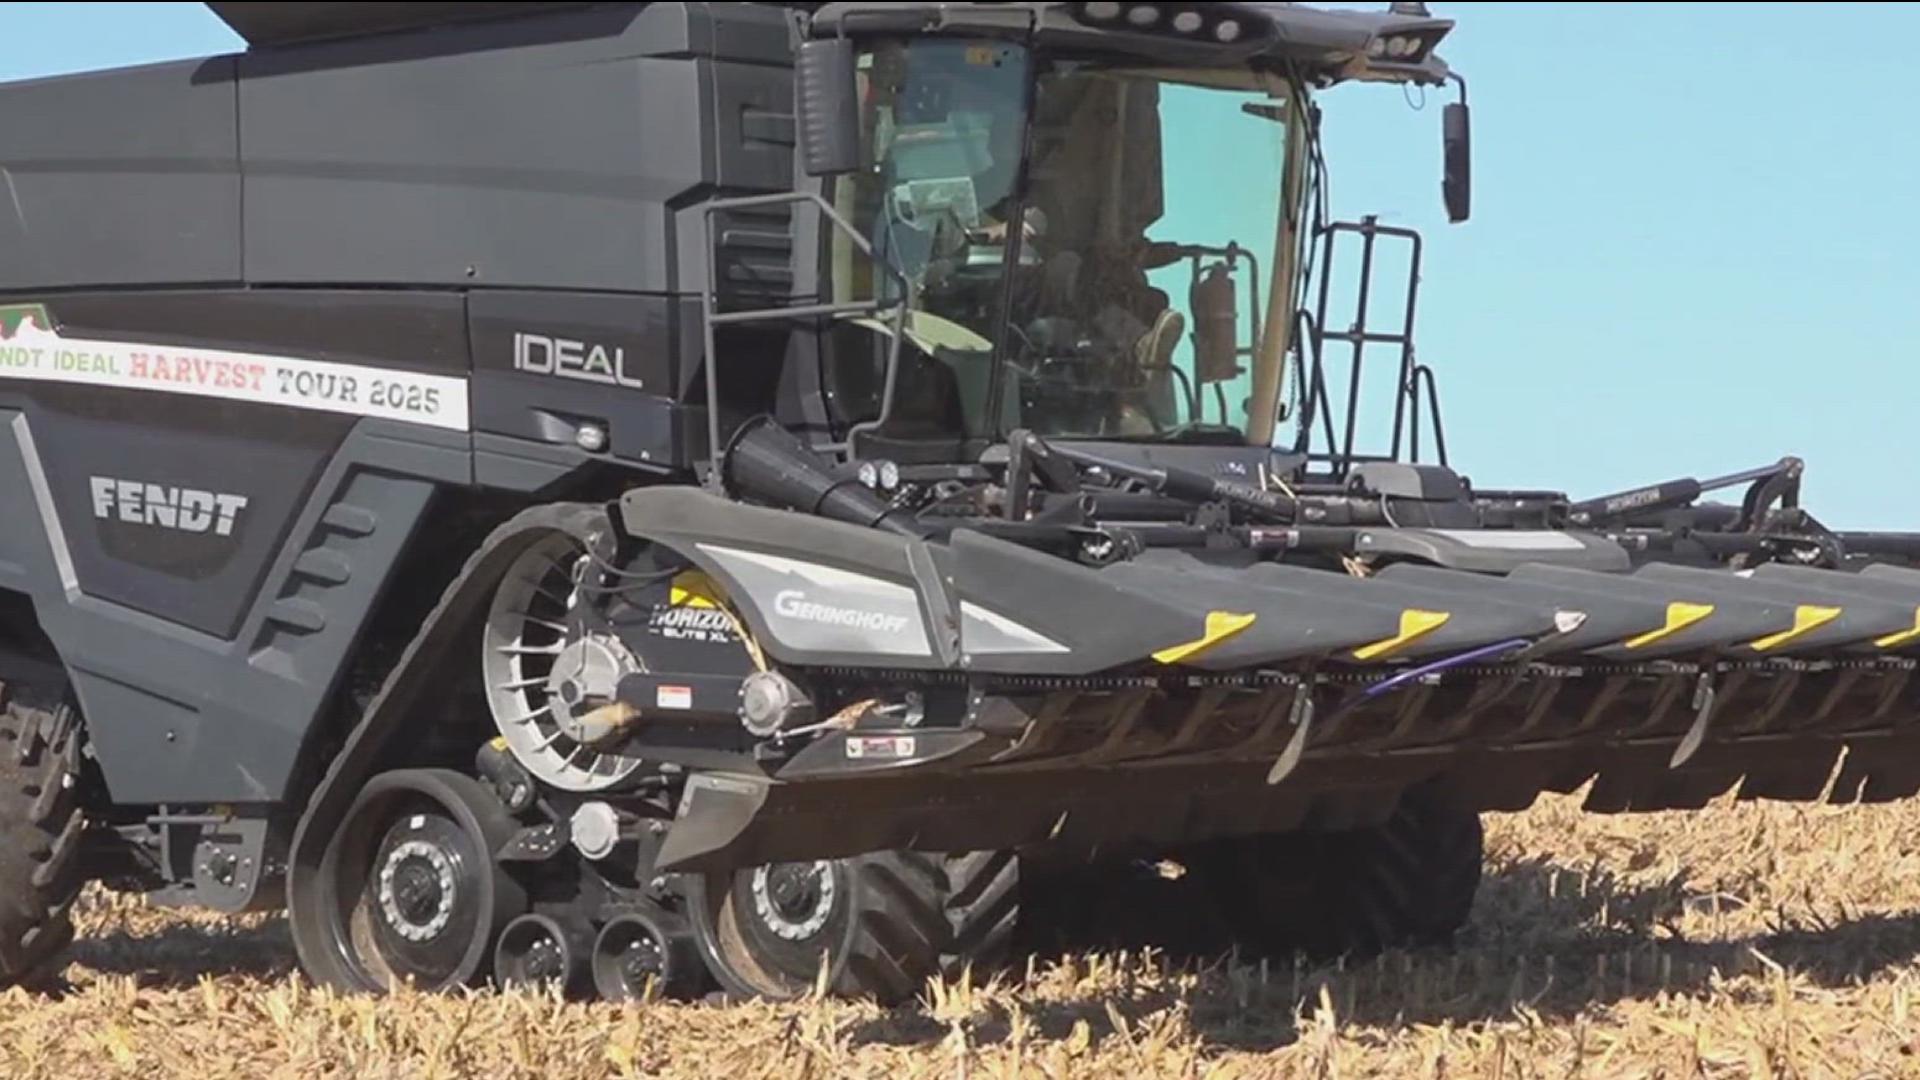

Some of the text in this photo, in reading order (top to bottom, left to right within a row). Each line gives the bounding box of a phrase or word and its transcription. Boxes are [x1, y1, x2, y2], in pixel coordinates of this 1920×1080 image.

[54, 350, 120, 375] IDEAL
[130, 353, 265, 391] HARVEST
[277, 368, 358, 403] TOUR
[370, 380, 440, 414] 2025
[514, 332, 643, 388] IDEAL
[90, 475, 248, 536] FENDT
[709, 631, 729, 643] XL
